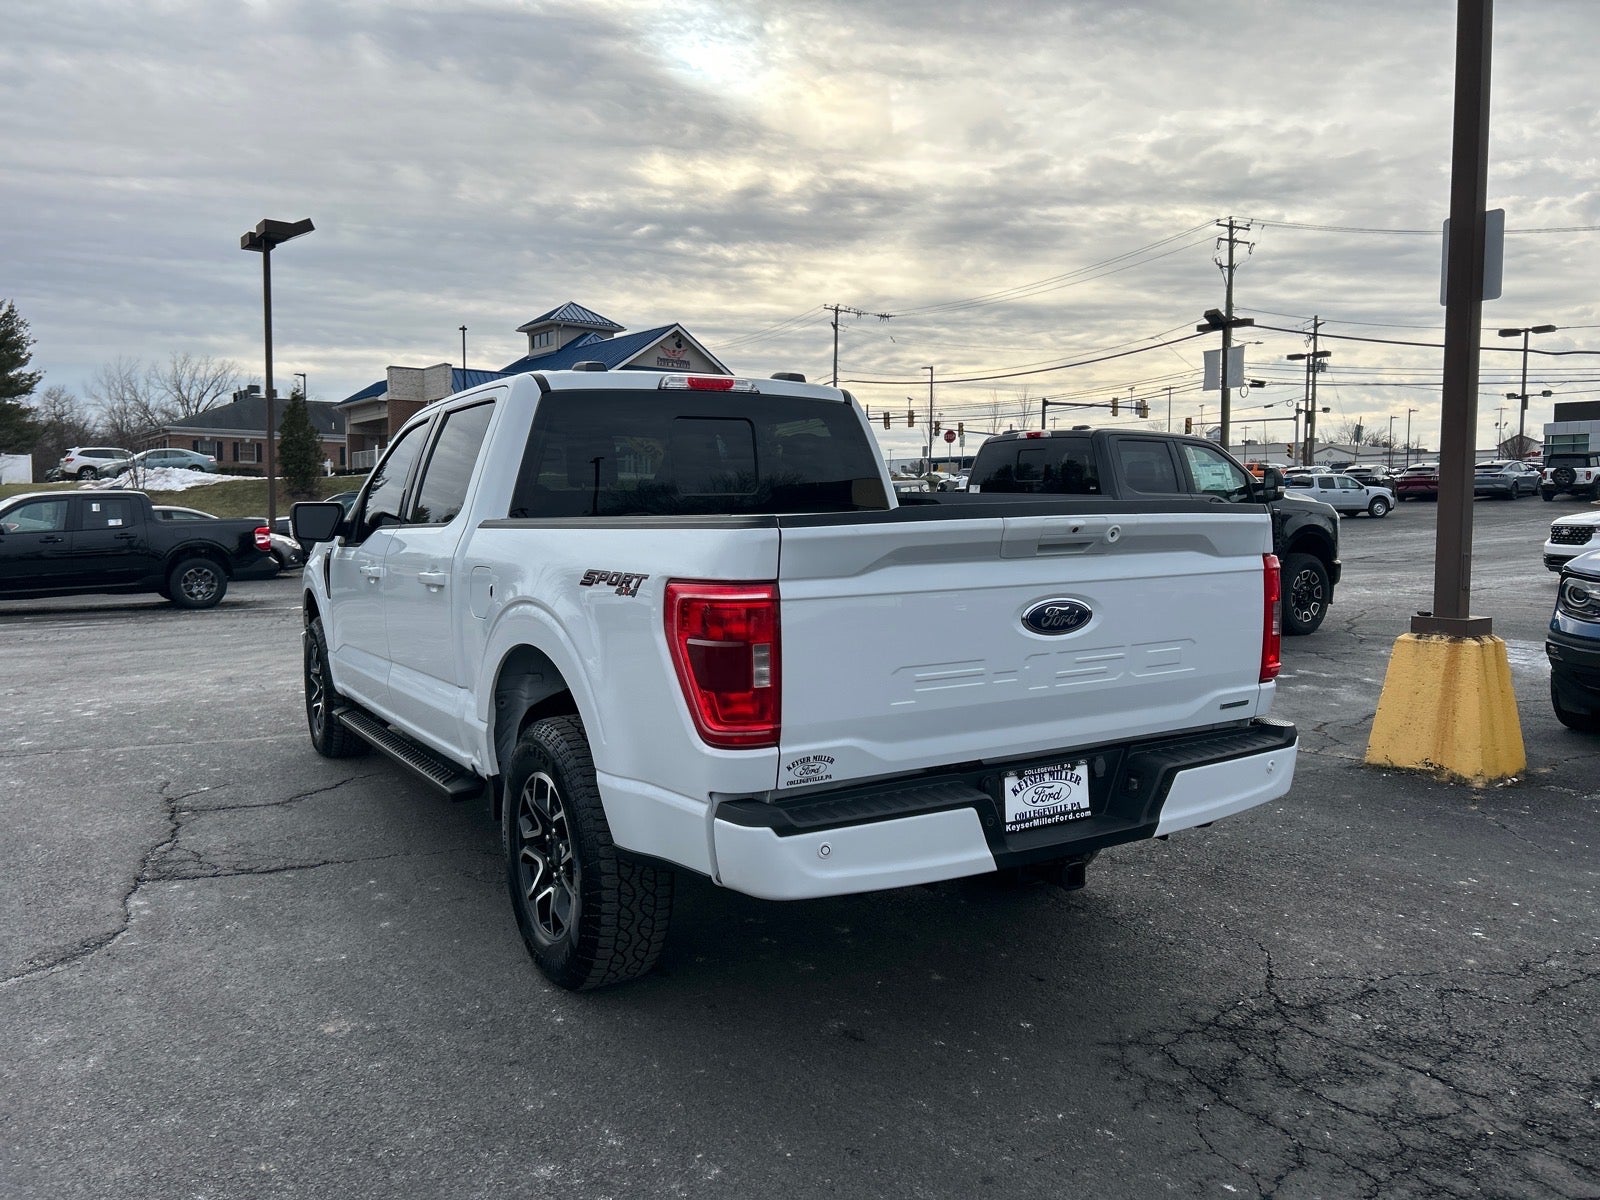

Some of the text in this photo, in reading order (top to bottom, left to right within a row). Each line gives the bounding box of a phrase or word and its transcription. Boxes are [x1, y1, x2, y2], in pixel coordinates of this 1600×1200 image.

[579, 569, 650, 589] SPORT
[1041, 606, 1079, 627] Ford
[786, 754, 835, 772] KEYSER MILLER
[799, 764, 822, 776] Ford
[1011, 770, 1082, 797] KEYSER MILLER
[1031, 784, 1063, 804] Ford
[1005, 810, 1092, 832] KeyserMillerFord.com
